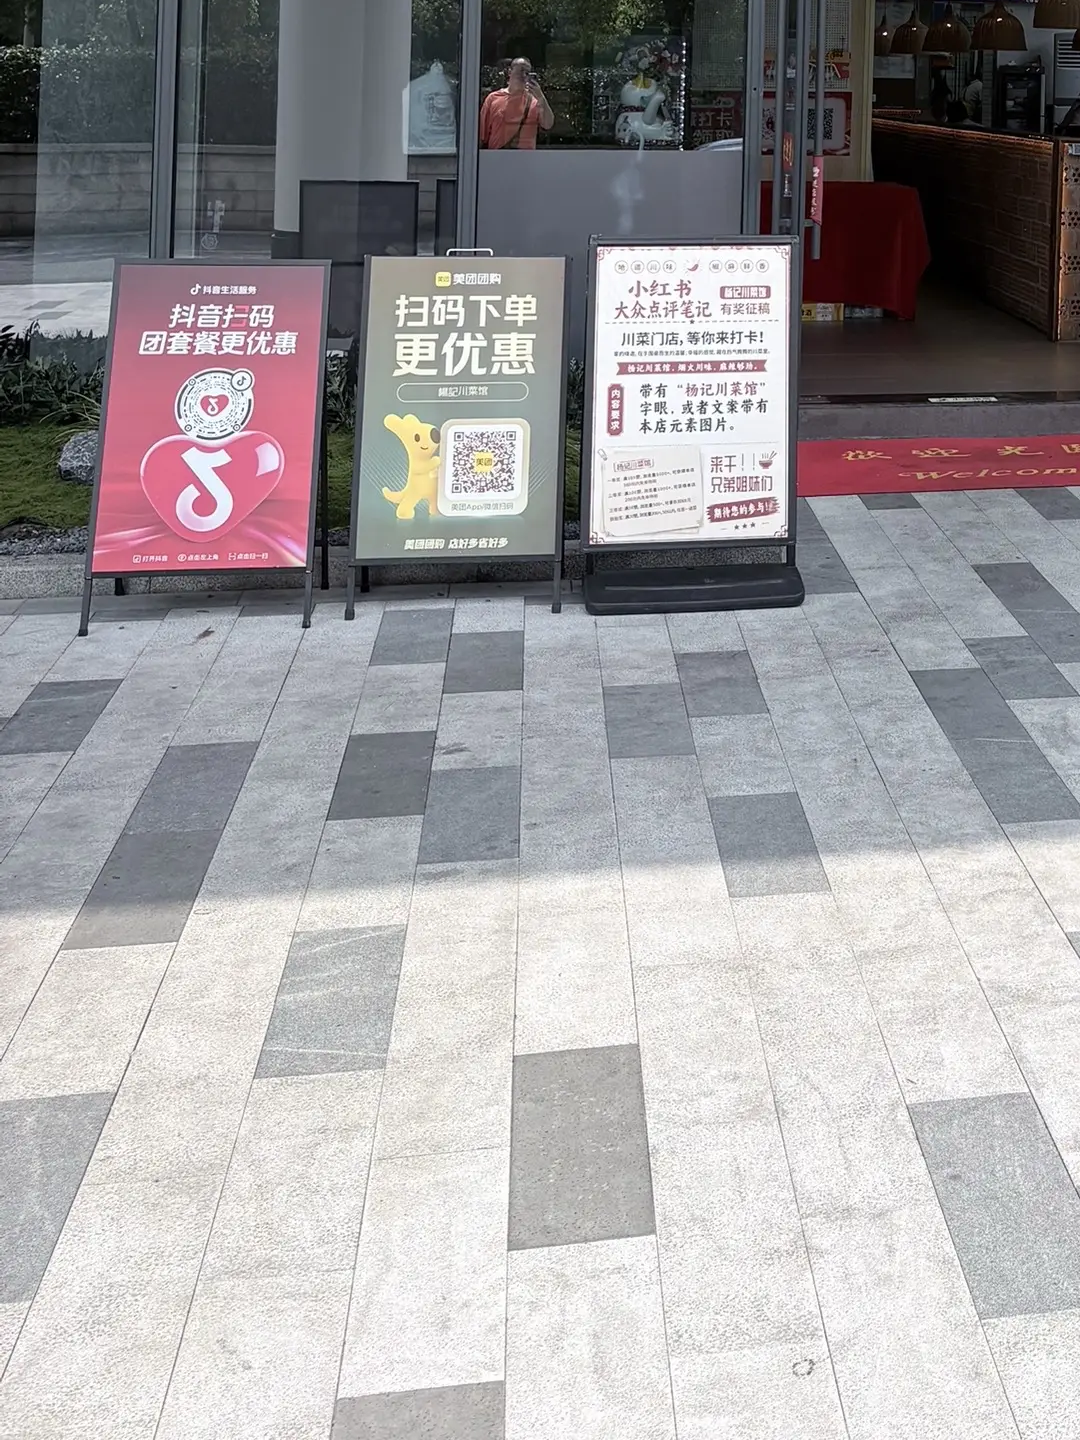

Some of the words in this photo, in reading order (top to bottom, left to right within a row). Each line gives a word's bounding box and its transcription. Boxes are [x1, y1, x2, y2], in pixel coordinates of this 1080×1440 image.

[452, 273, 502, 285] 美团团购
[628, 279, 692, 299] 小红书
[168, 303, 275, 329] 抖音扫码
[395, 294, 538, 328] 扫码下单
[614, 300, 713, 320] 大众点评笔记
[720, 302, 771, 316] 有奖征稿
[138, 330, 299, 356] 团套餐更优惠
[392, 332, 537, 377] 更优惠
[610, 389, 621, 430] 内容要求
[711, 475, 773, 494] 兄弟姐妹们
